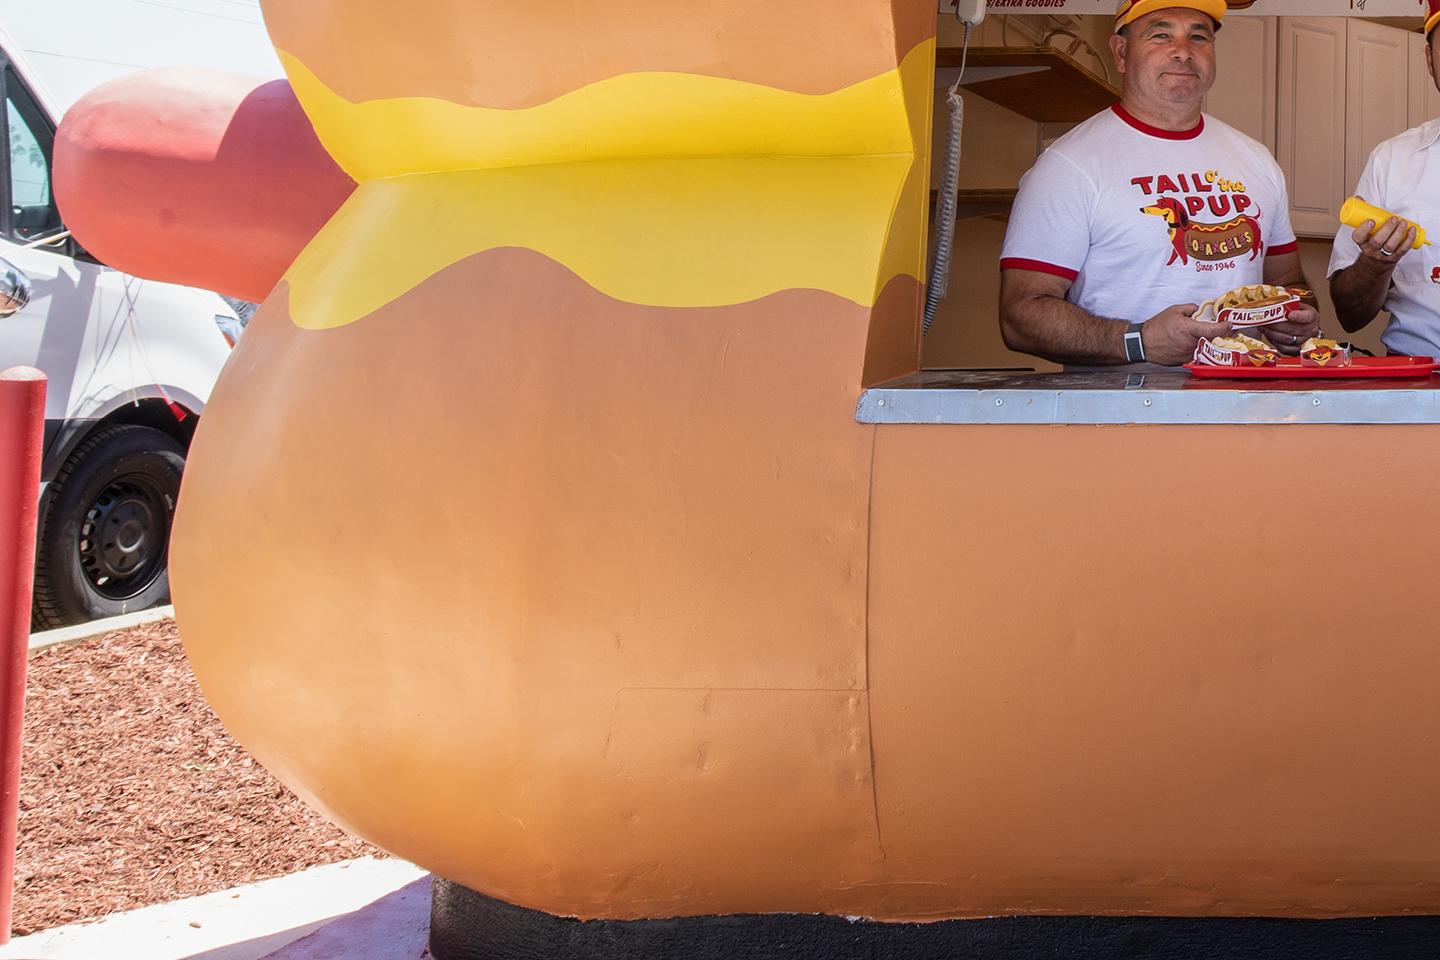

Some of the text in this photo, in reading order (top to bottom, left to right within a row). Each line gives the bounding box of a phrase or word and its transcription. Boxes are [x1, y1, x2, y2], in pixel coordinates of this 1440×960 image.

[1025, 0, 1066, 7] GOODIES
[1131, 173, 1212, 195] TAIL
[1185, 194, 1251, 217] PUP
[1206, 232, 1252, 255] ANGELES
[1215, 260, 1235, 271] 1946
[1232, 312, 1252, 320] TAIL
[1264, 307, 1281, 318] PUP
